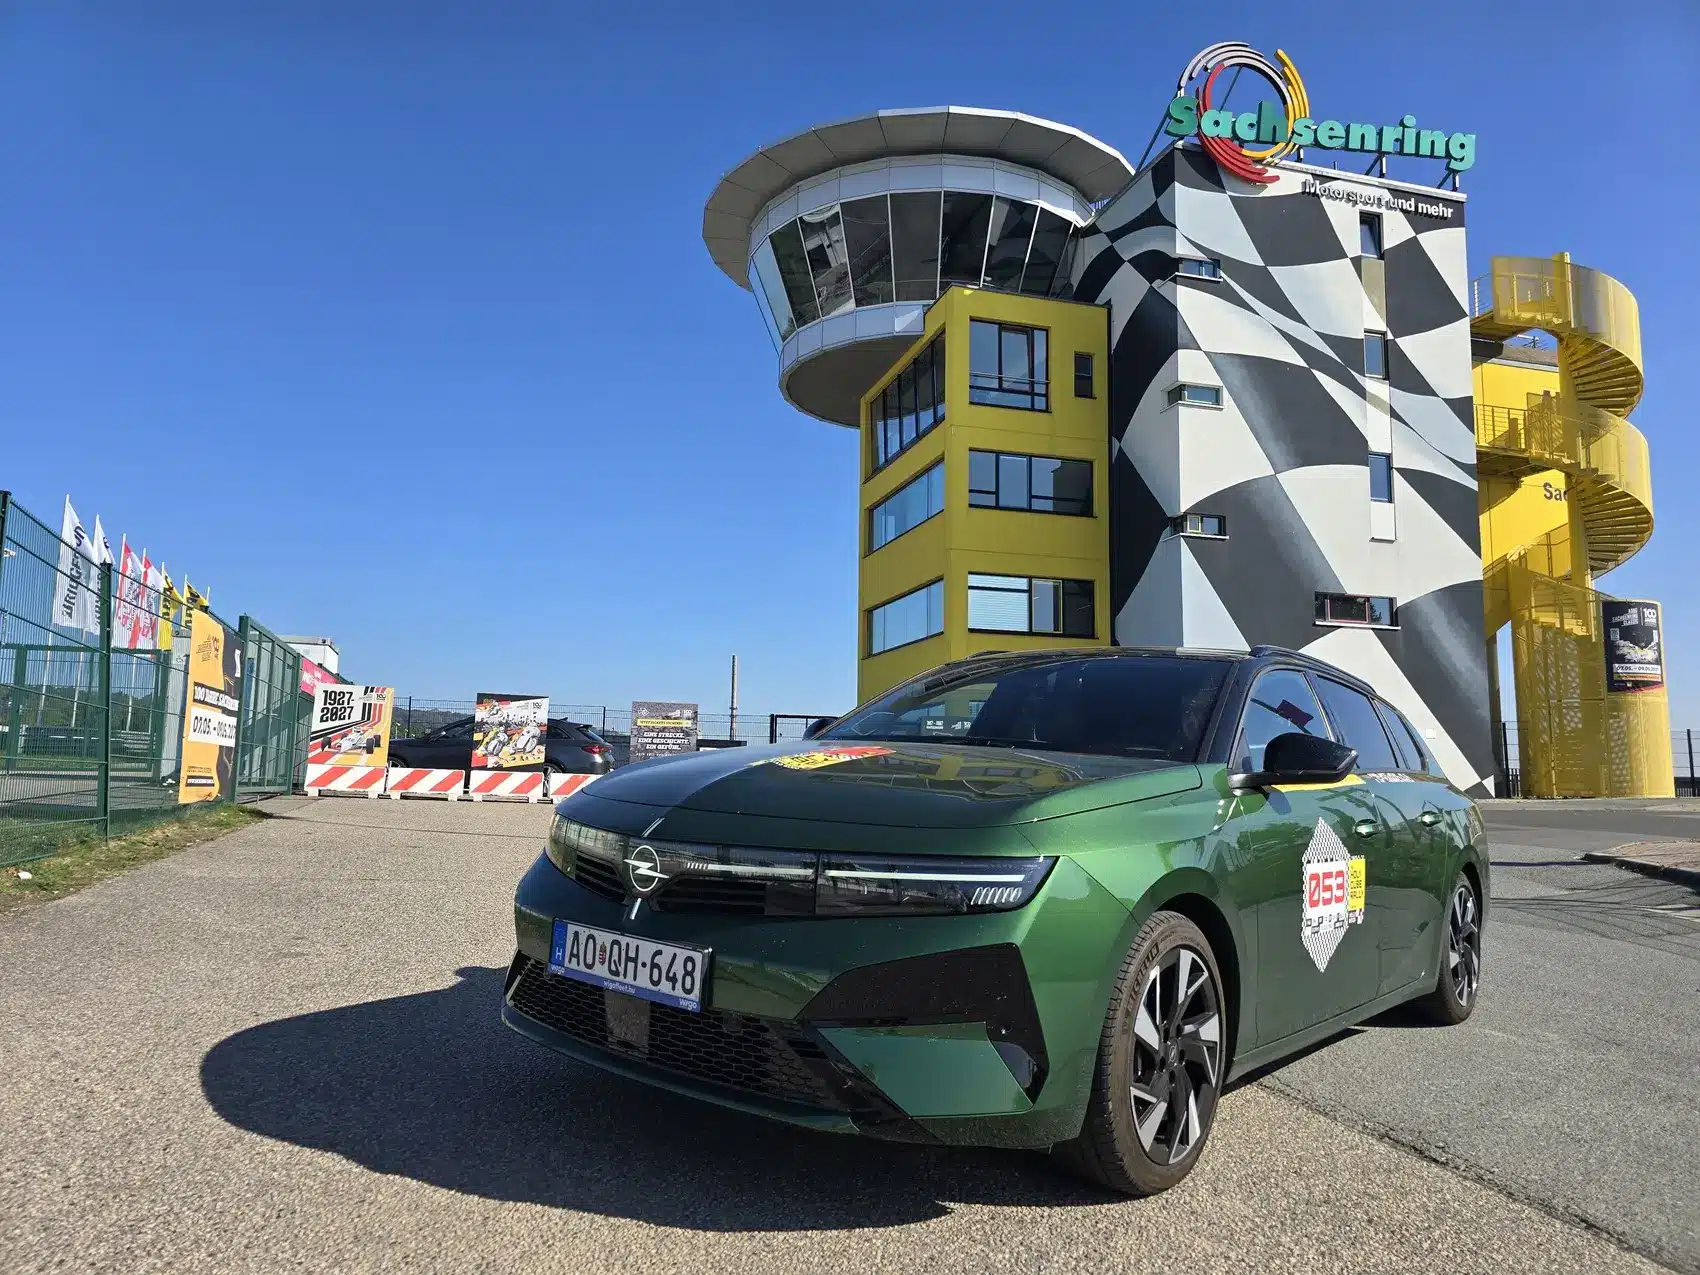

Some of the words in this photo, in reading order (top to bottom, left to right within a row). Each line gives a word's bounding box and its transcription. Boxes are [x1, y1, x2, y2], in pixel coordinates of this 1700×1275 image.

[1165, 95, 1476, 172] Sachsenring
[1302, 178, 1386, 207] Motorsport
[1389, 193, 1415, 213] und
[1417, 202, 1454, 220] mehr
[1643, 608, 1657, 619] 100
[322, 690, 354, 706] 1927-
[320, 706, 354, 723] 2027
[1308, 870, 1345, 908] 053
[555, 947, 563, 961] H
[568, 930, 597, 970] AO
[679, 998, 698, 1010] wigo
